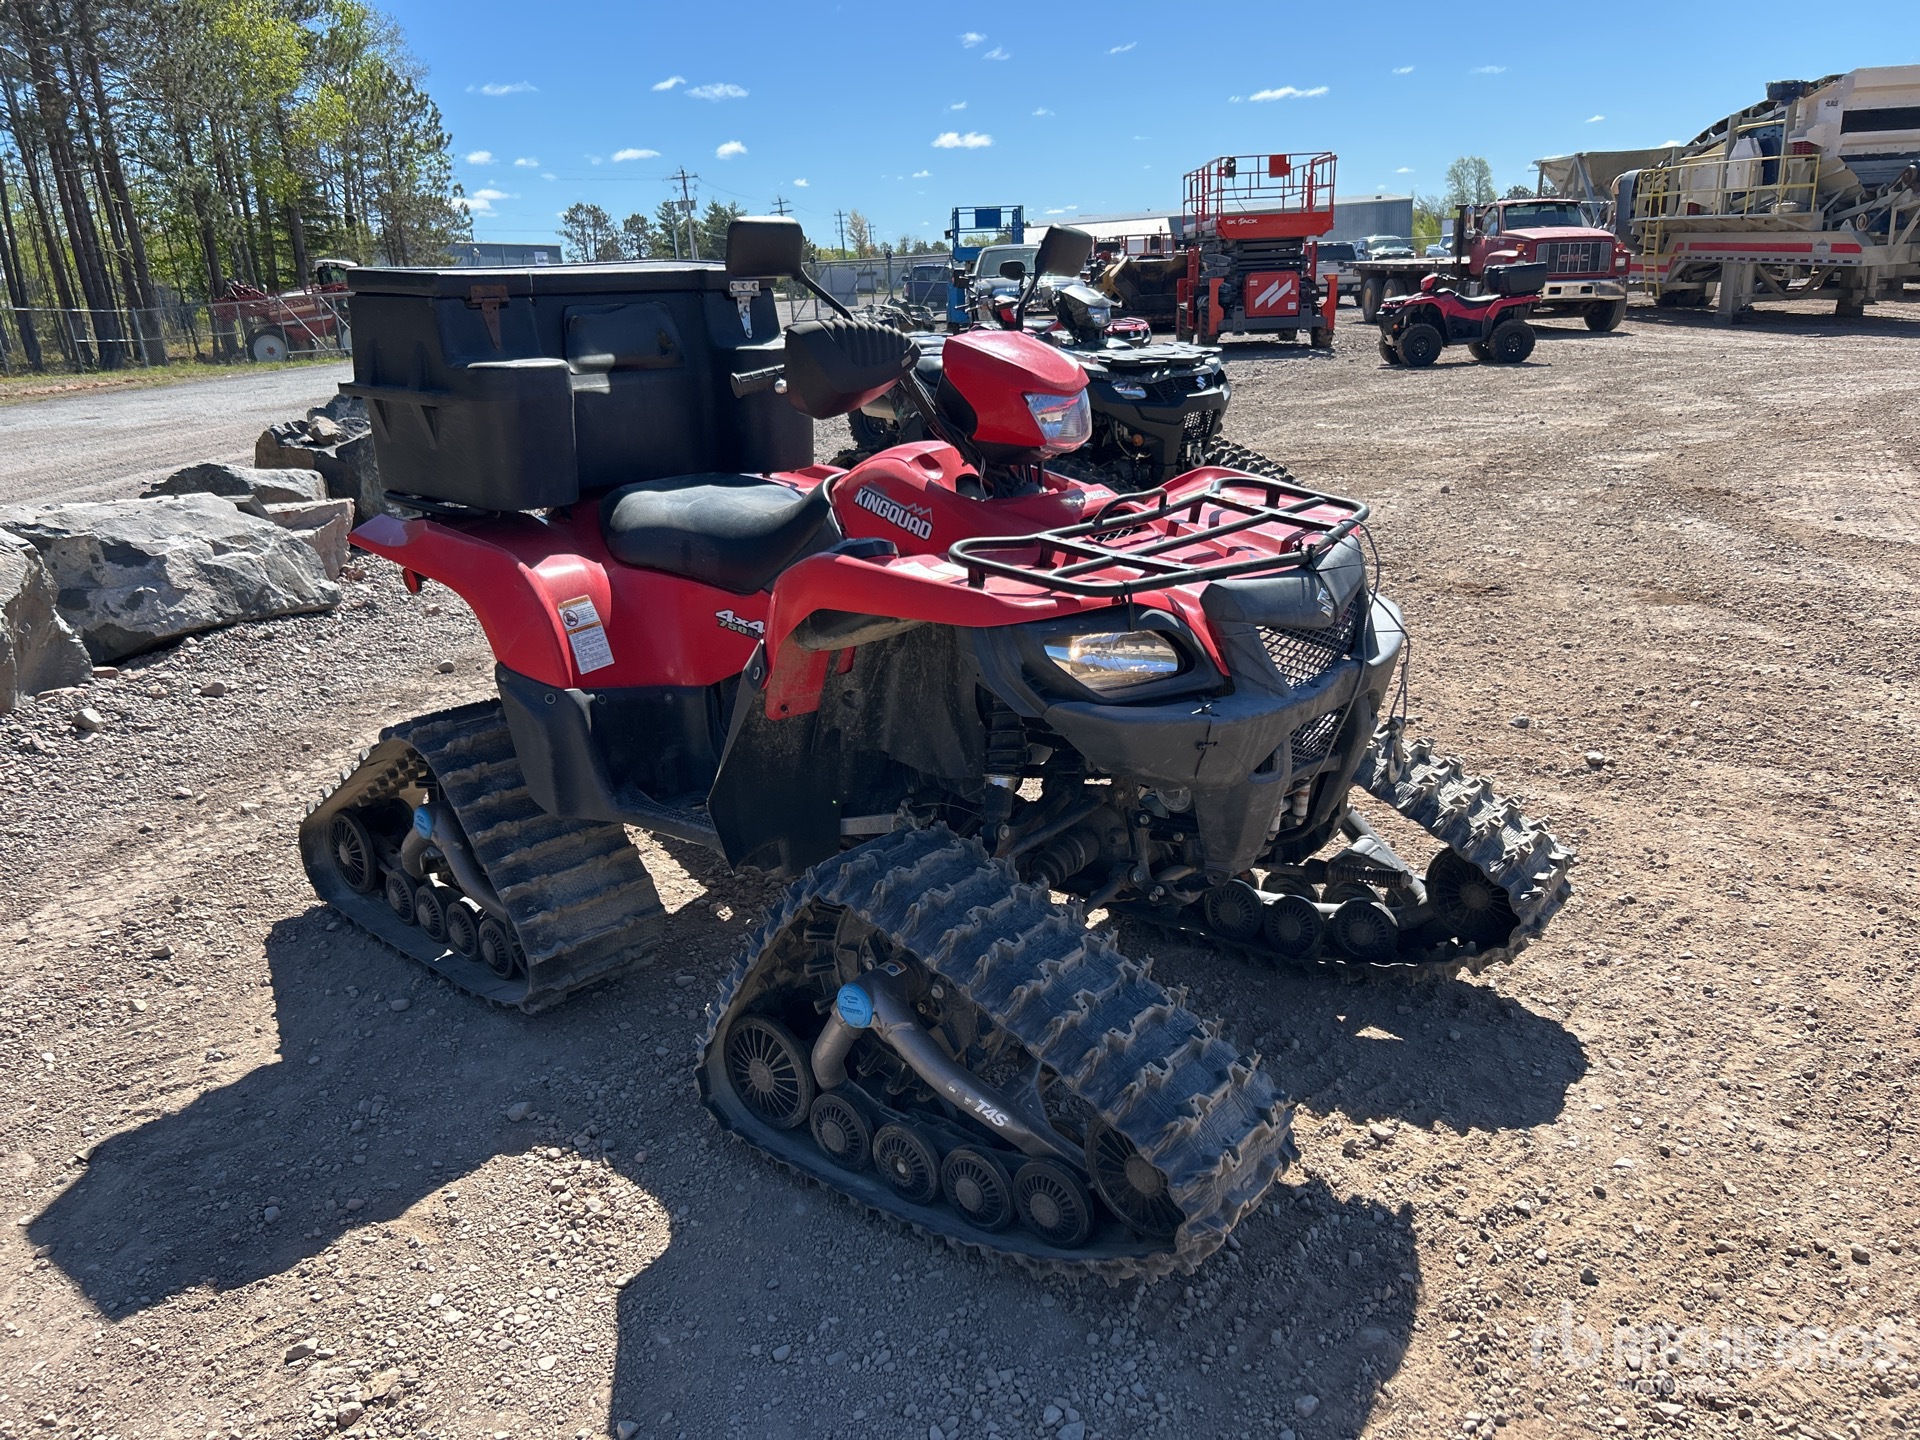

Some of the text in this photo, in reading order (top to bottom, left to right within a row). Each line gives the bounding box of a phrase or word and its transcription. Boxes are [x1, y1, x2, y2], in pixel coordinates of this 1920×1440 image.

[1559, 253, 1590, 263] GMC
[853, 487, 934, 541] KINGQUAD
[715, 609, 765, 634] 4x4
[974, 1098, 1009, 1127] T4S
